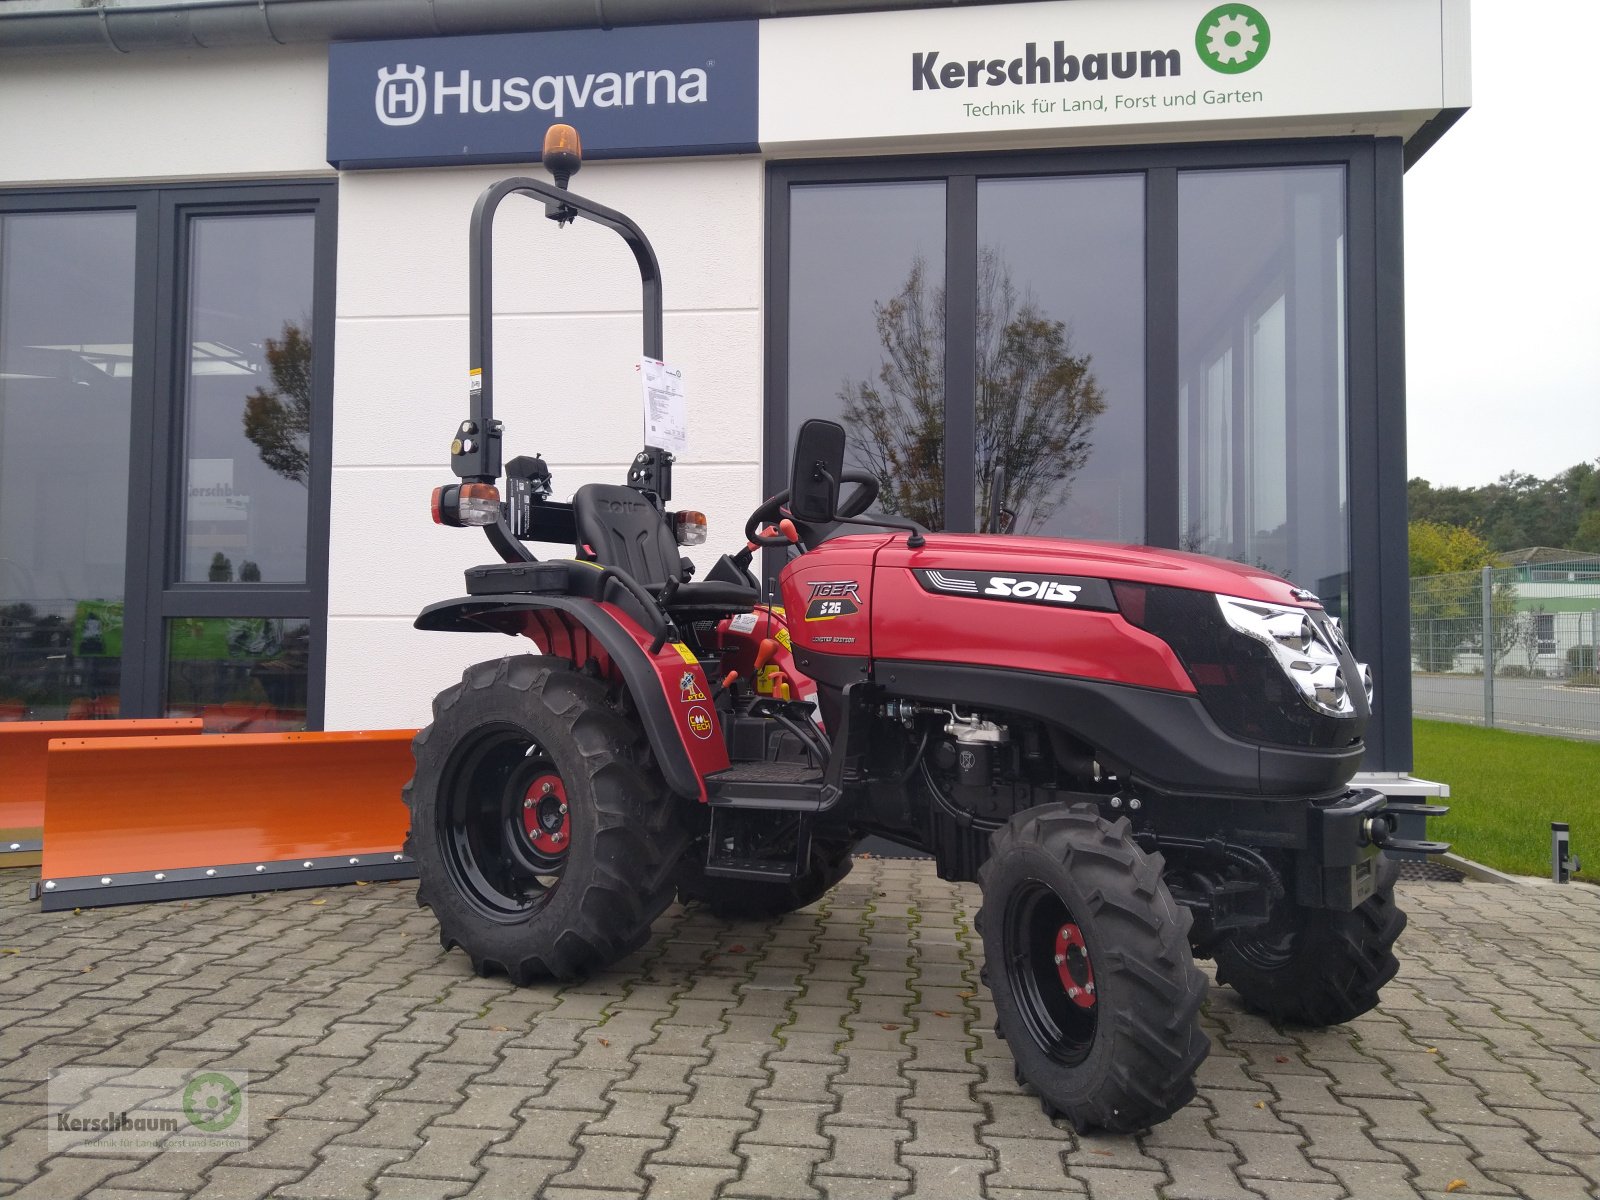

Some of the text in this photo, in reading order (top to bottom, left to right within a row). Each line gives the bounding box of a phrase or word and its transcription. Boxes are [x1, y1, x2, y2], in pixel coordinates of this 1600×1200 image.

[912, 40, 1181, 91] Kerschbaum
[433, 67, 708, 118] Husqvarna
[963, 89, 1264, 118] Technik für Land, Forst und Garten
[807, 580, 863, 604] TIGER
[827, 601, 842, 614] 26
[688, 692, 704, 701] PTO
[691, 723, 711, 731] TECH
